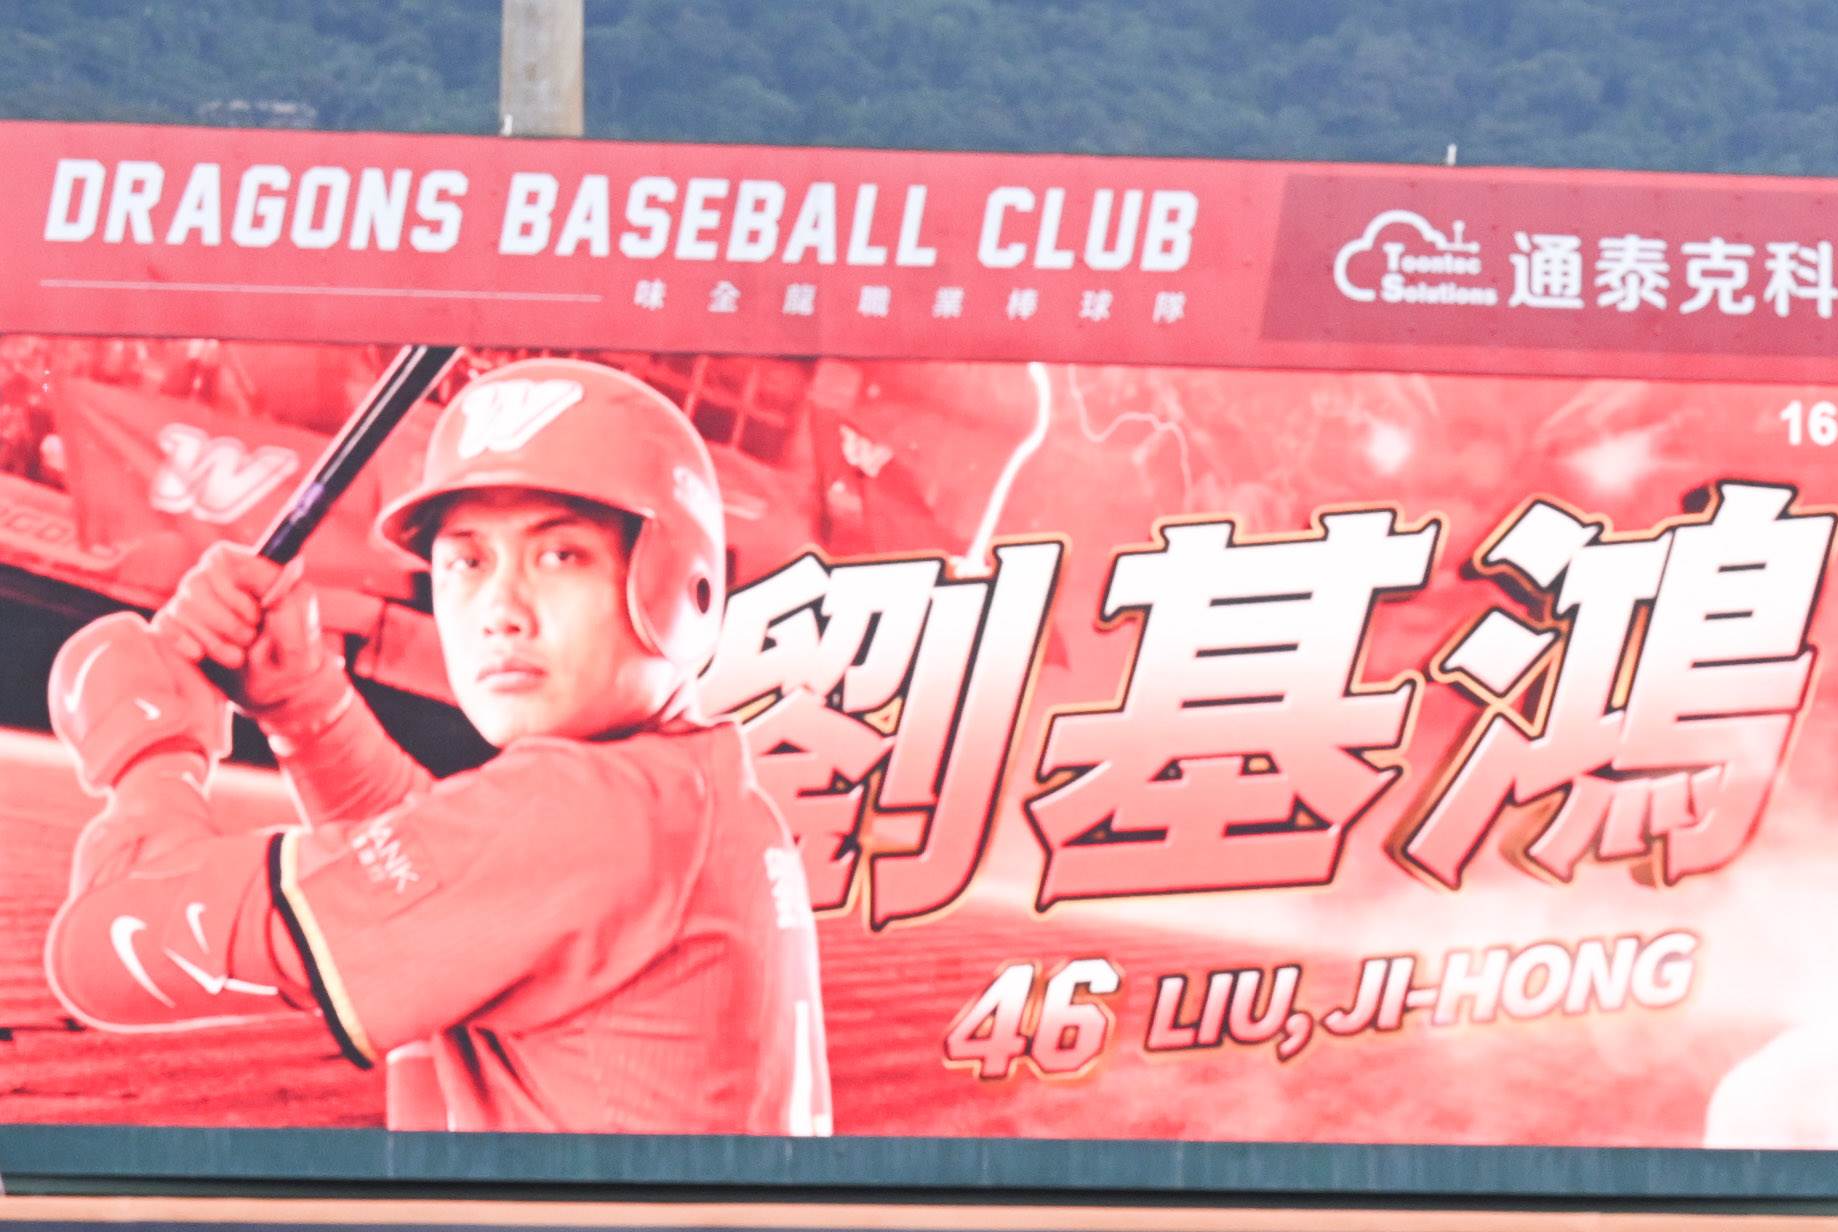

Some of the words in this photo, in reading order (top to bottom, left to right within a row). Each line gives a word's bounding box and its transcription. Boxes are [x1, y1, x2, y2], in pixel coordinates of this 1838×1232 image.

[44, 158, 468, 253] DRAGONS
[498, 173, 939, 268] BASEBALL
[977, 186, 1200, 272] CLUB
[634, 279, 1187, 322] 味全龍職業棒球隊
[698, 482, 1838, 930] 劉基鴻
[944, 955, 1122, 1078] 46
[1145, 964, 1312, 1060] LIU,
[1322, 930, 1700, 1036] JI-HONG
